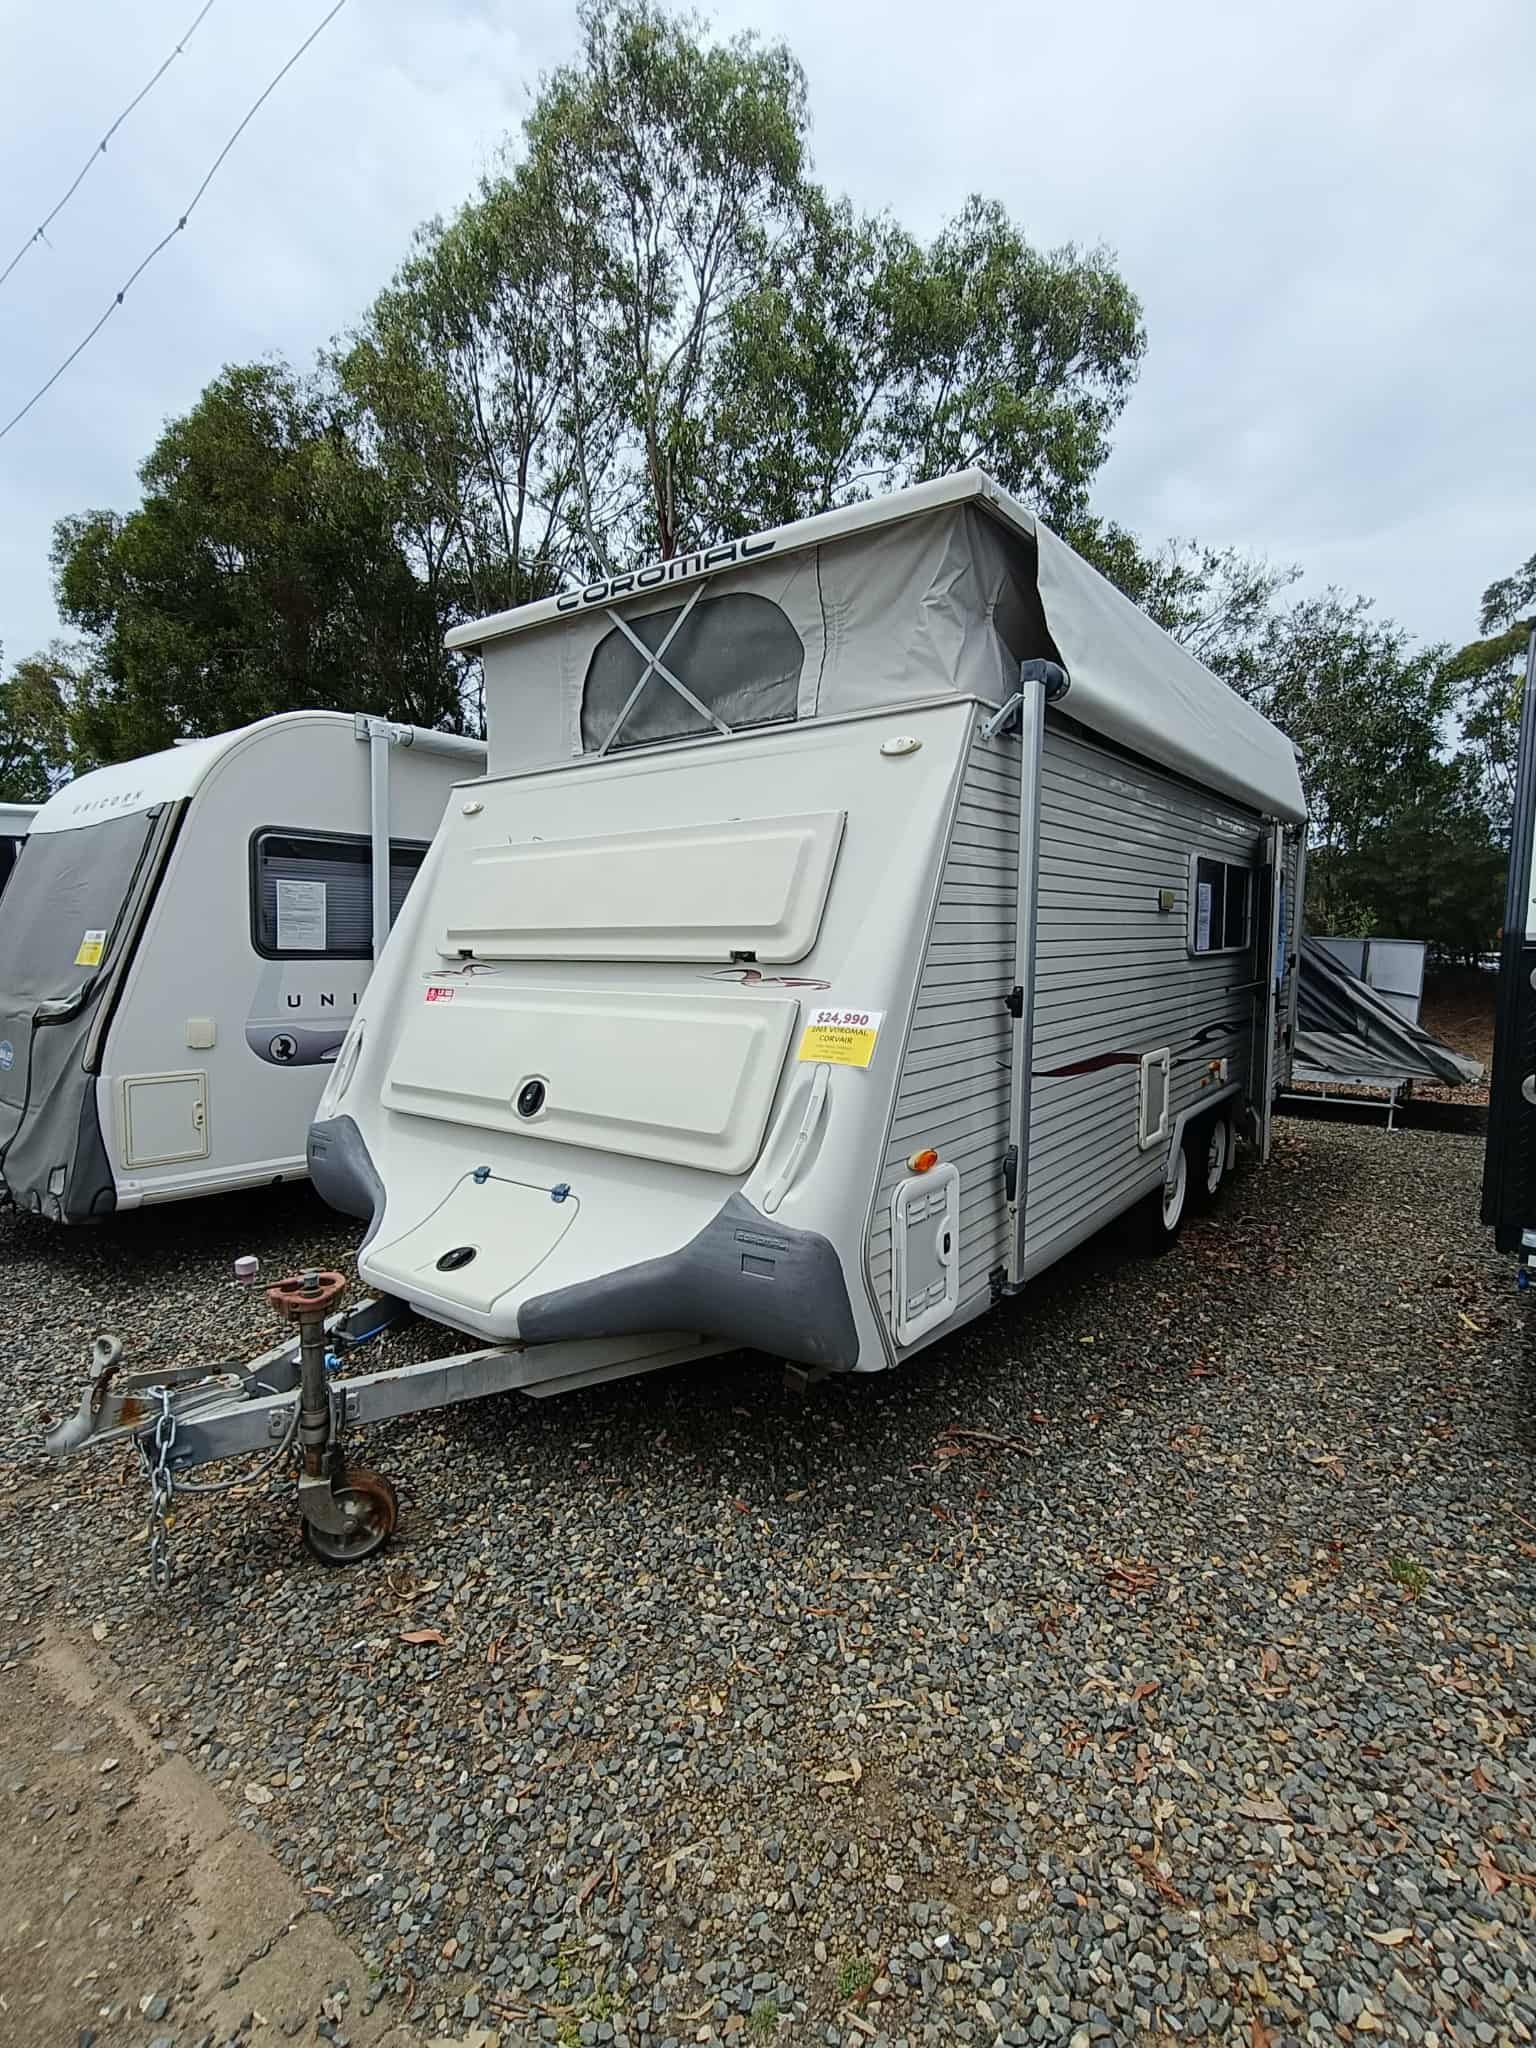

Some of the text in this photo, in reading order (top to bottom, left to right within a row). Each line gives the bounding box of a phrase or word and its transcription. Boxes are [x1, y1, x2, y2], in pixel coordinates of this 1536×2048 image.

[556, 539, 776, 612] COROMAL
[816, 1011, 869, 1026] $24,990
[819, 1034, 854, 1044] CORVAIR
